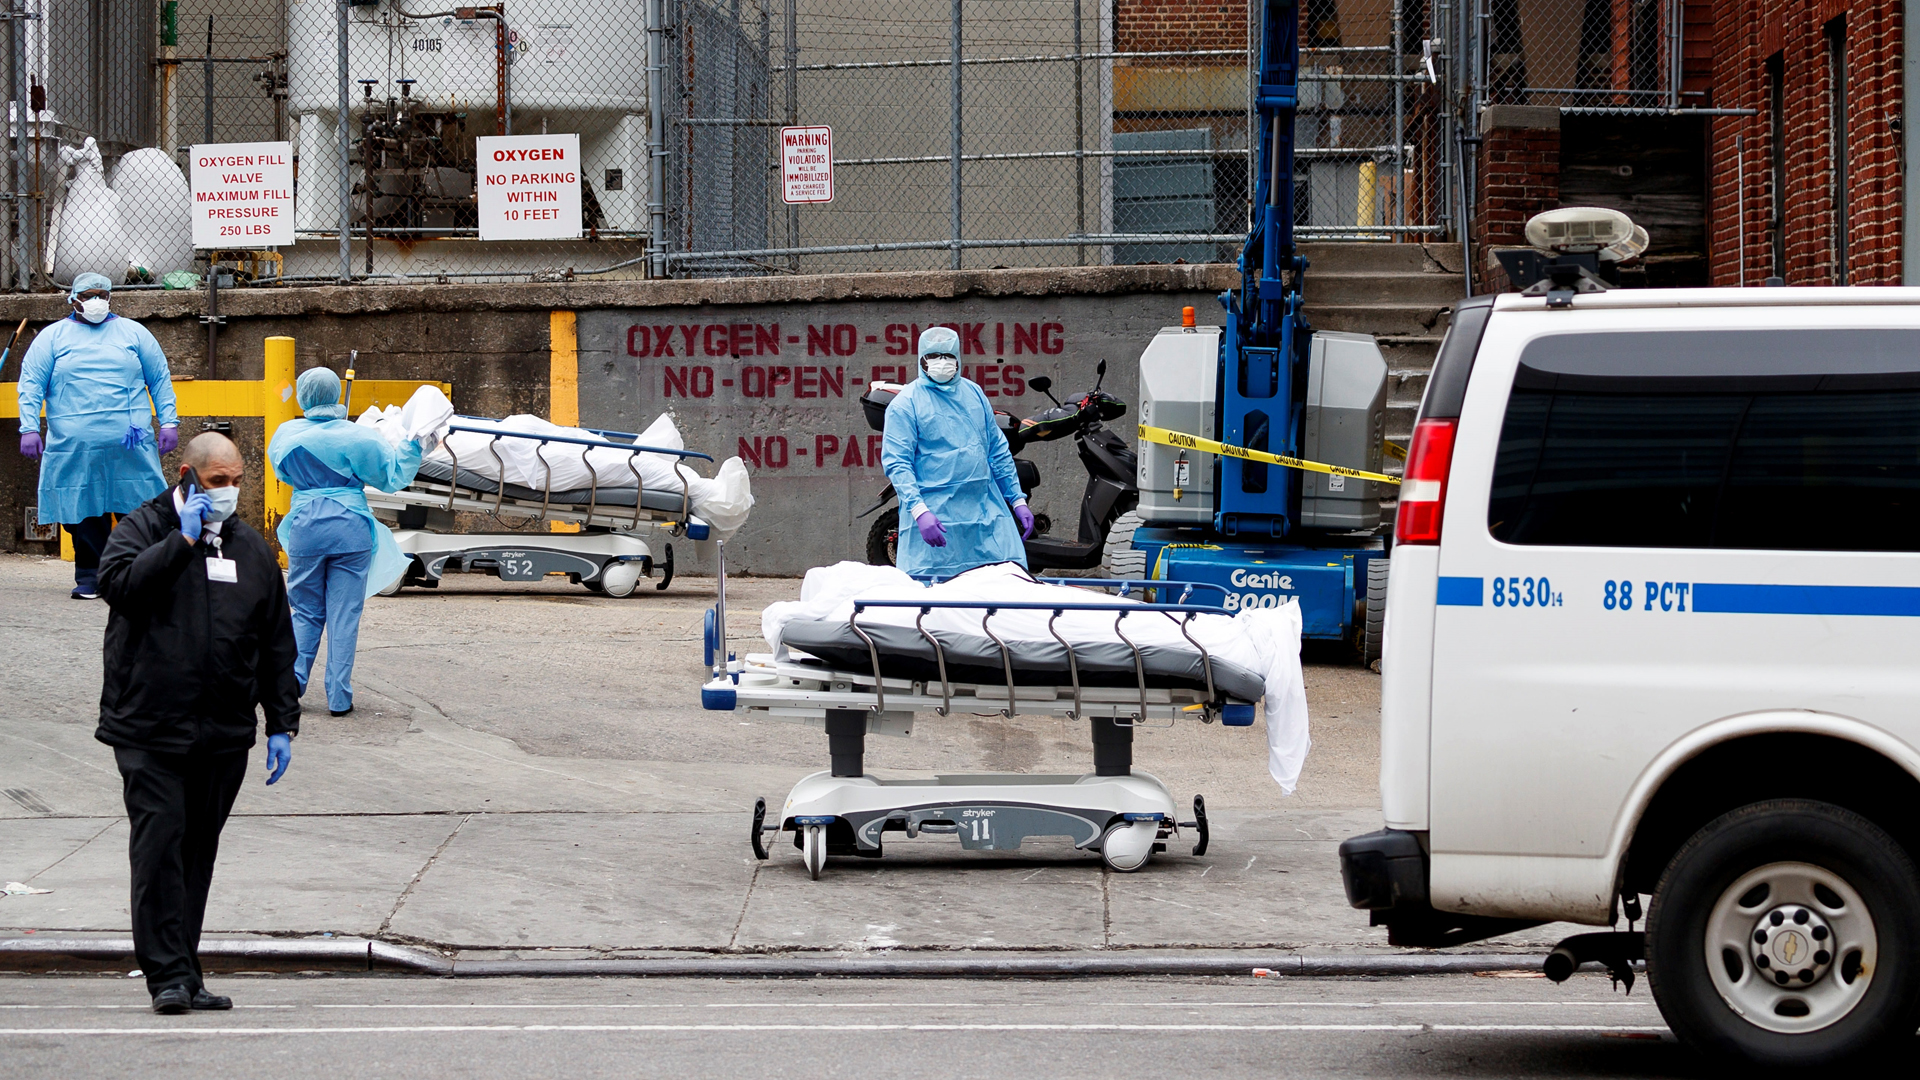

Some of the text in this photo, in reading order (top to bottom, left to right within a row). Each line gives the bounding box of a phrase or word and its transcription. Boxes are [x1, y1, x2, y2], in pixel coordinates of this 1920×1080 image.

[413, 38, 442, 52] 40105
[785, 133, 828, 146] WARNING
[199, 155, 285, 167] OXYGEN FILL
[493, 148, 564, 162] OXYGEN
[788, 155, 825, 164] VIOLATORS
[222, 173, 263, 184] VALVE
[486, 172, 575, 185] NO PARKING
[787, 172, 829, 182] IMMOBILIZED
[196, 189, 290, 202] MAXIMUM FILL
[507, 191, 557, 203] WITHIN
[208, 207, 279, 219] PRESSURE
[503, 208, 560, 221] 10 FEET
[220, 224, 271, 236] 250 LBS
[1168, 432, 1197, 448] CAUTION
[1230, 568, 1293, 590] Genie
[1223, 592, 1300, 610] BOOM
[1603, 580, 1690, 612] 88 PCT
[962, 808, 996, 818] stryker
[971, 818, 990, 841] 11
